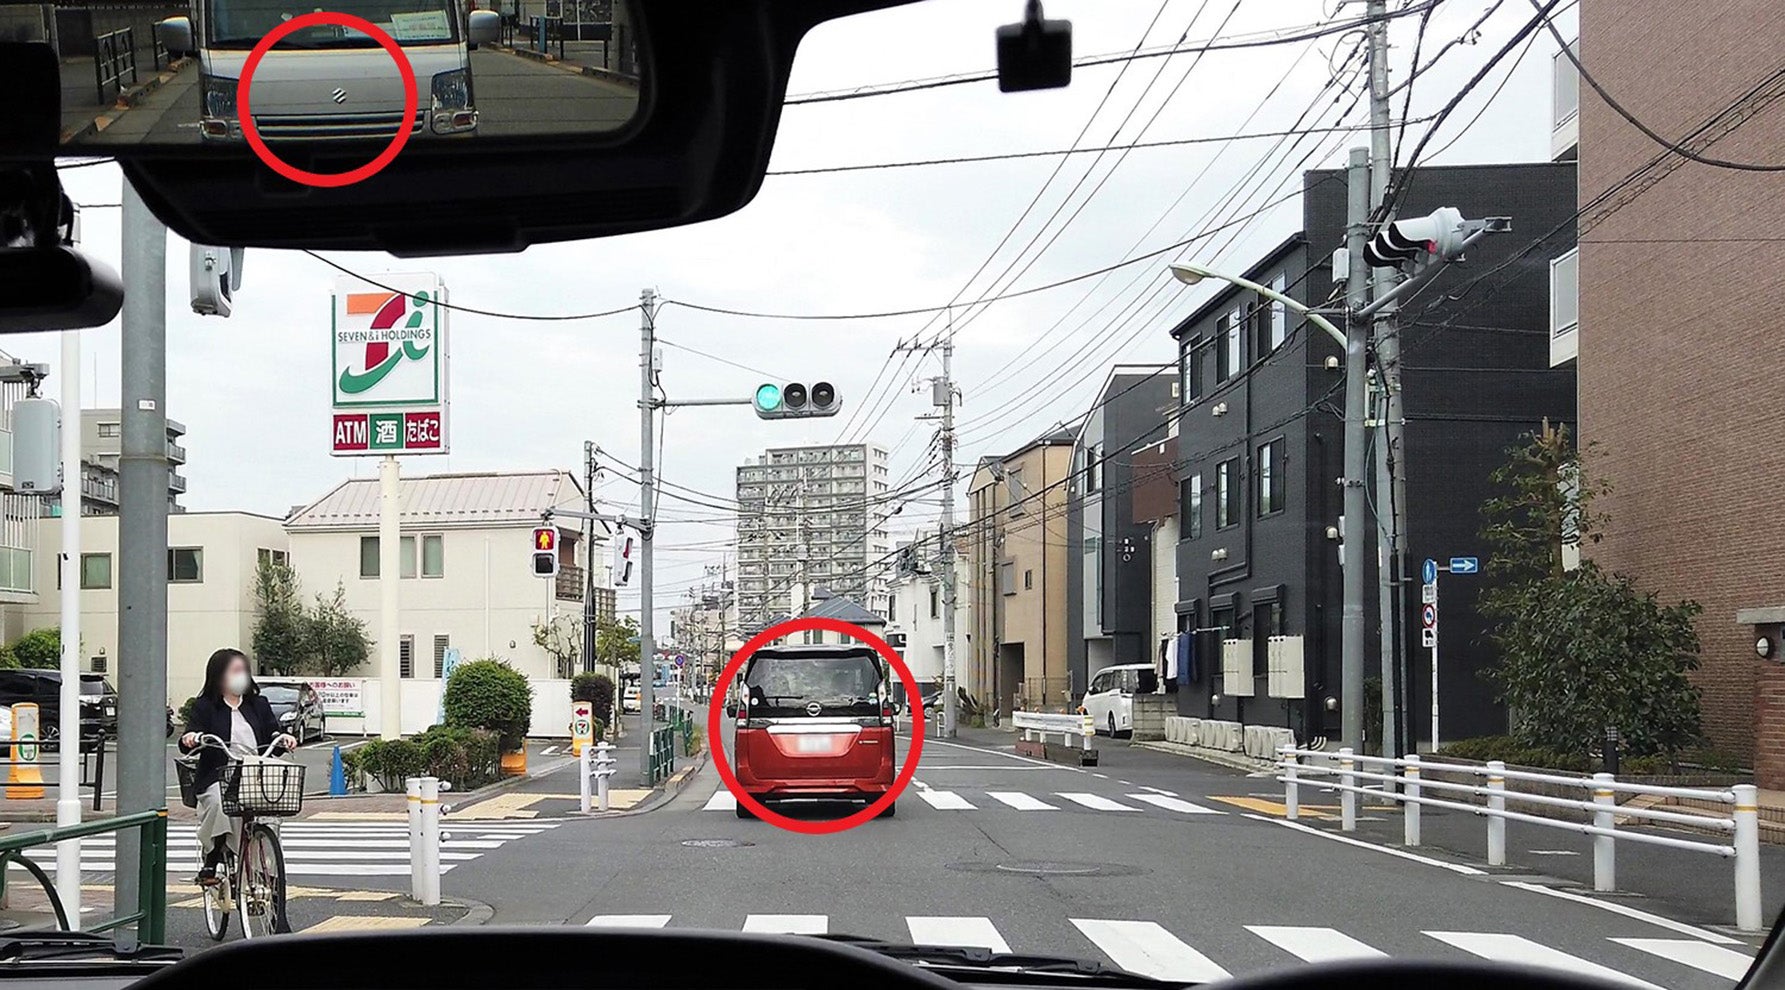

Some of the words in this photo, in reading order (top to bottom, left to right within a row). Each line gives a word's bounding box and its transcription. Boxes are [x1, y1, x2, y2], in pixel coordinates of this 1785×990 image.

[381, 328, 431, 341] HOLDINGS
[335, 421, 366, 444] ATM
[376, 420, 398, 444] 酒
[406, 418, 439, 442] たばこ
